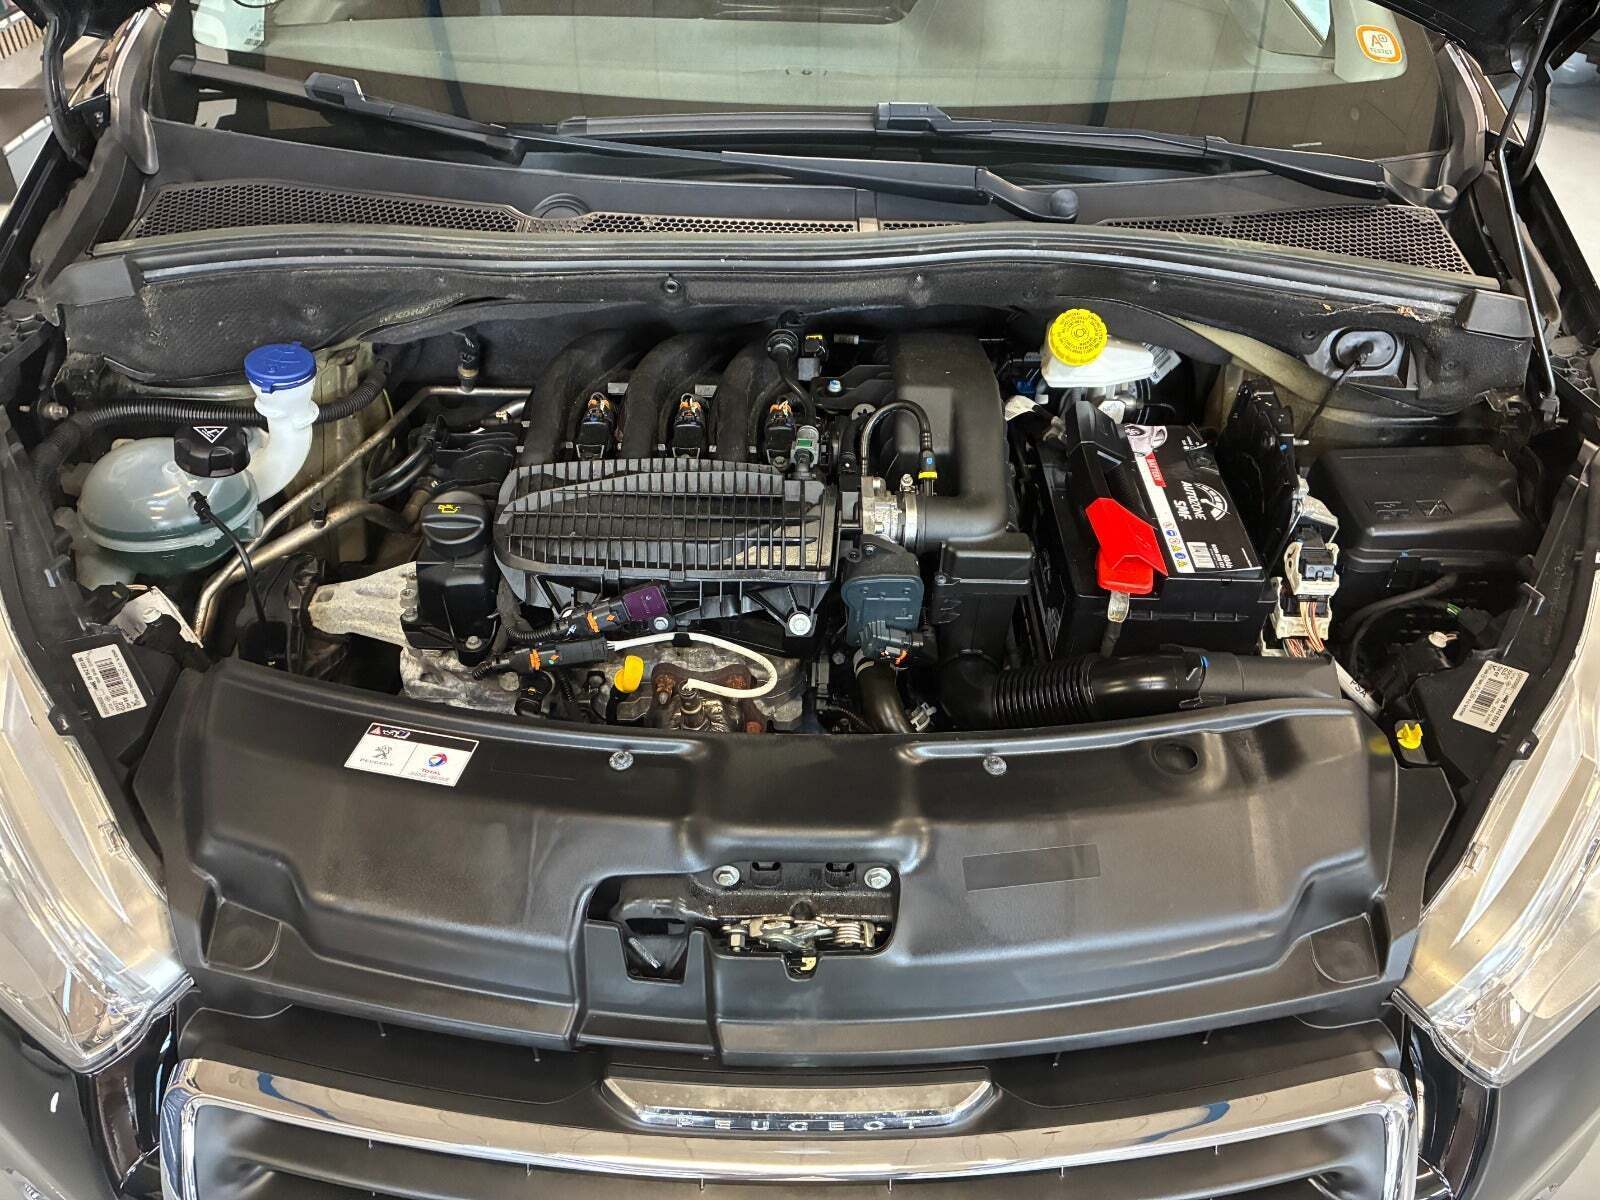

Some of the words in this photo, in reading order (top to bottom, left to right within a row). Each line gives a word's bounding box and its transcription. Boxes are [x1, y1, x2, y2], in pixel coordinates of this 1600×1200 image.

[1181, 480, 1207, 520] AUTOZONE
[1173, 500, 1193, 520] SMF
[421, 768, 441, 776] TOTAL
[676, 1113, 921, 1131] PEUGEOT
